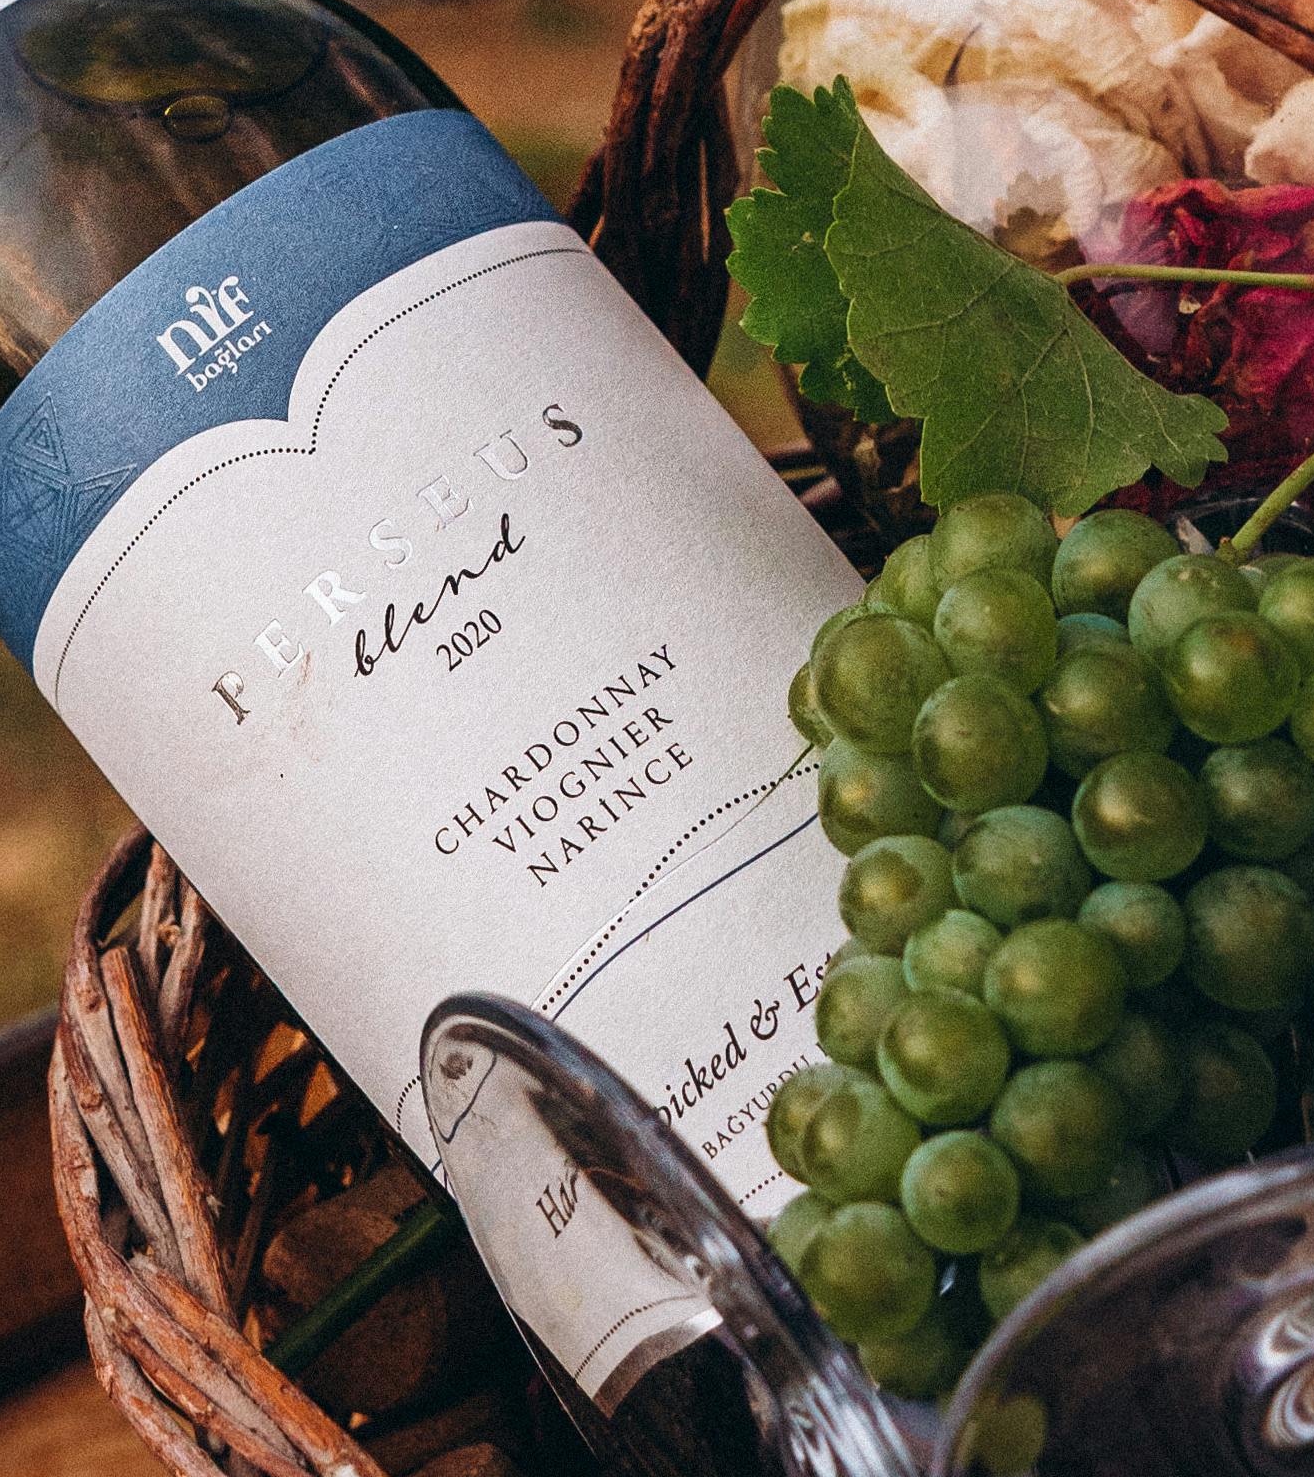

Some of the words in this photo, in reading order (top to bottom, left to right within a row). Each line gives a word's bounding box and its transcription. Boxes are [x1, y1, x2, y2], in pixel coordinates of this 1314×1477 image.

[211, 403, 583, 726] PERSEUS
[354, 512, 526, 678] blend
[436, 609, 502, 672] 2020
[435, 644, 676, 855] CHARDONNAY
[492, 707, 673, 853] VIOGNIER
[750, 999, 780, 1040] &
